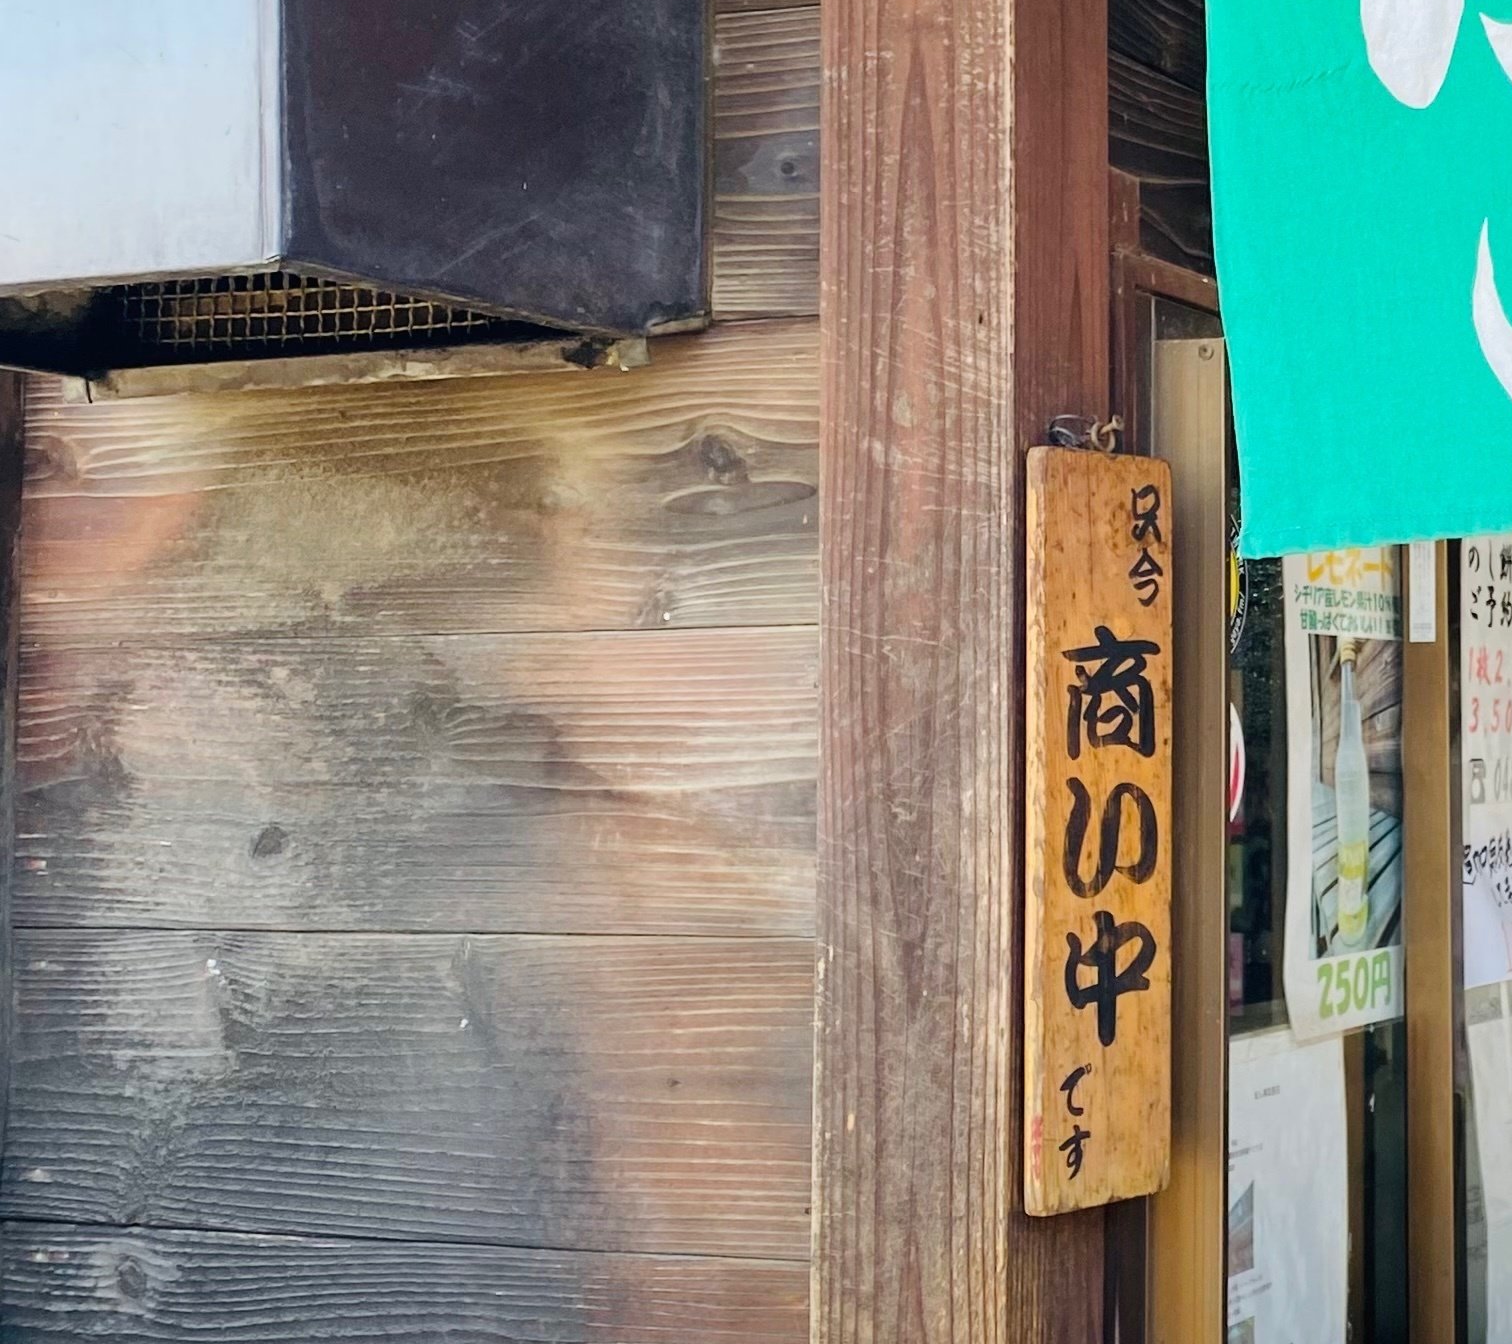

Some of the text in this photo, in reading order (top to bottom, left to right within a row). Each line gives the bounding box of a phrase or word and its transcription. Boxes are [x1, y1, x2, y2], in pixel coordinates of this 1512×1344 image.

[1058, 485, 1163, 1180] 只今 商い中 です
[1317, 942, 1391, 1019] 250円
